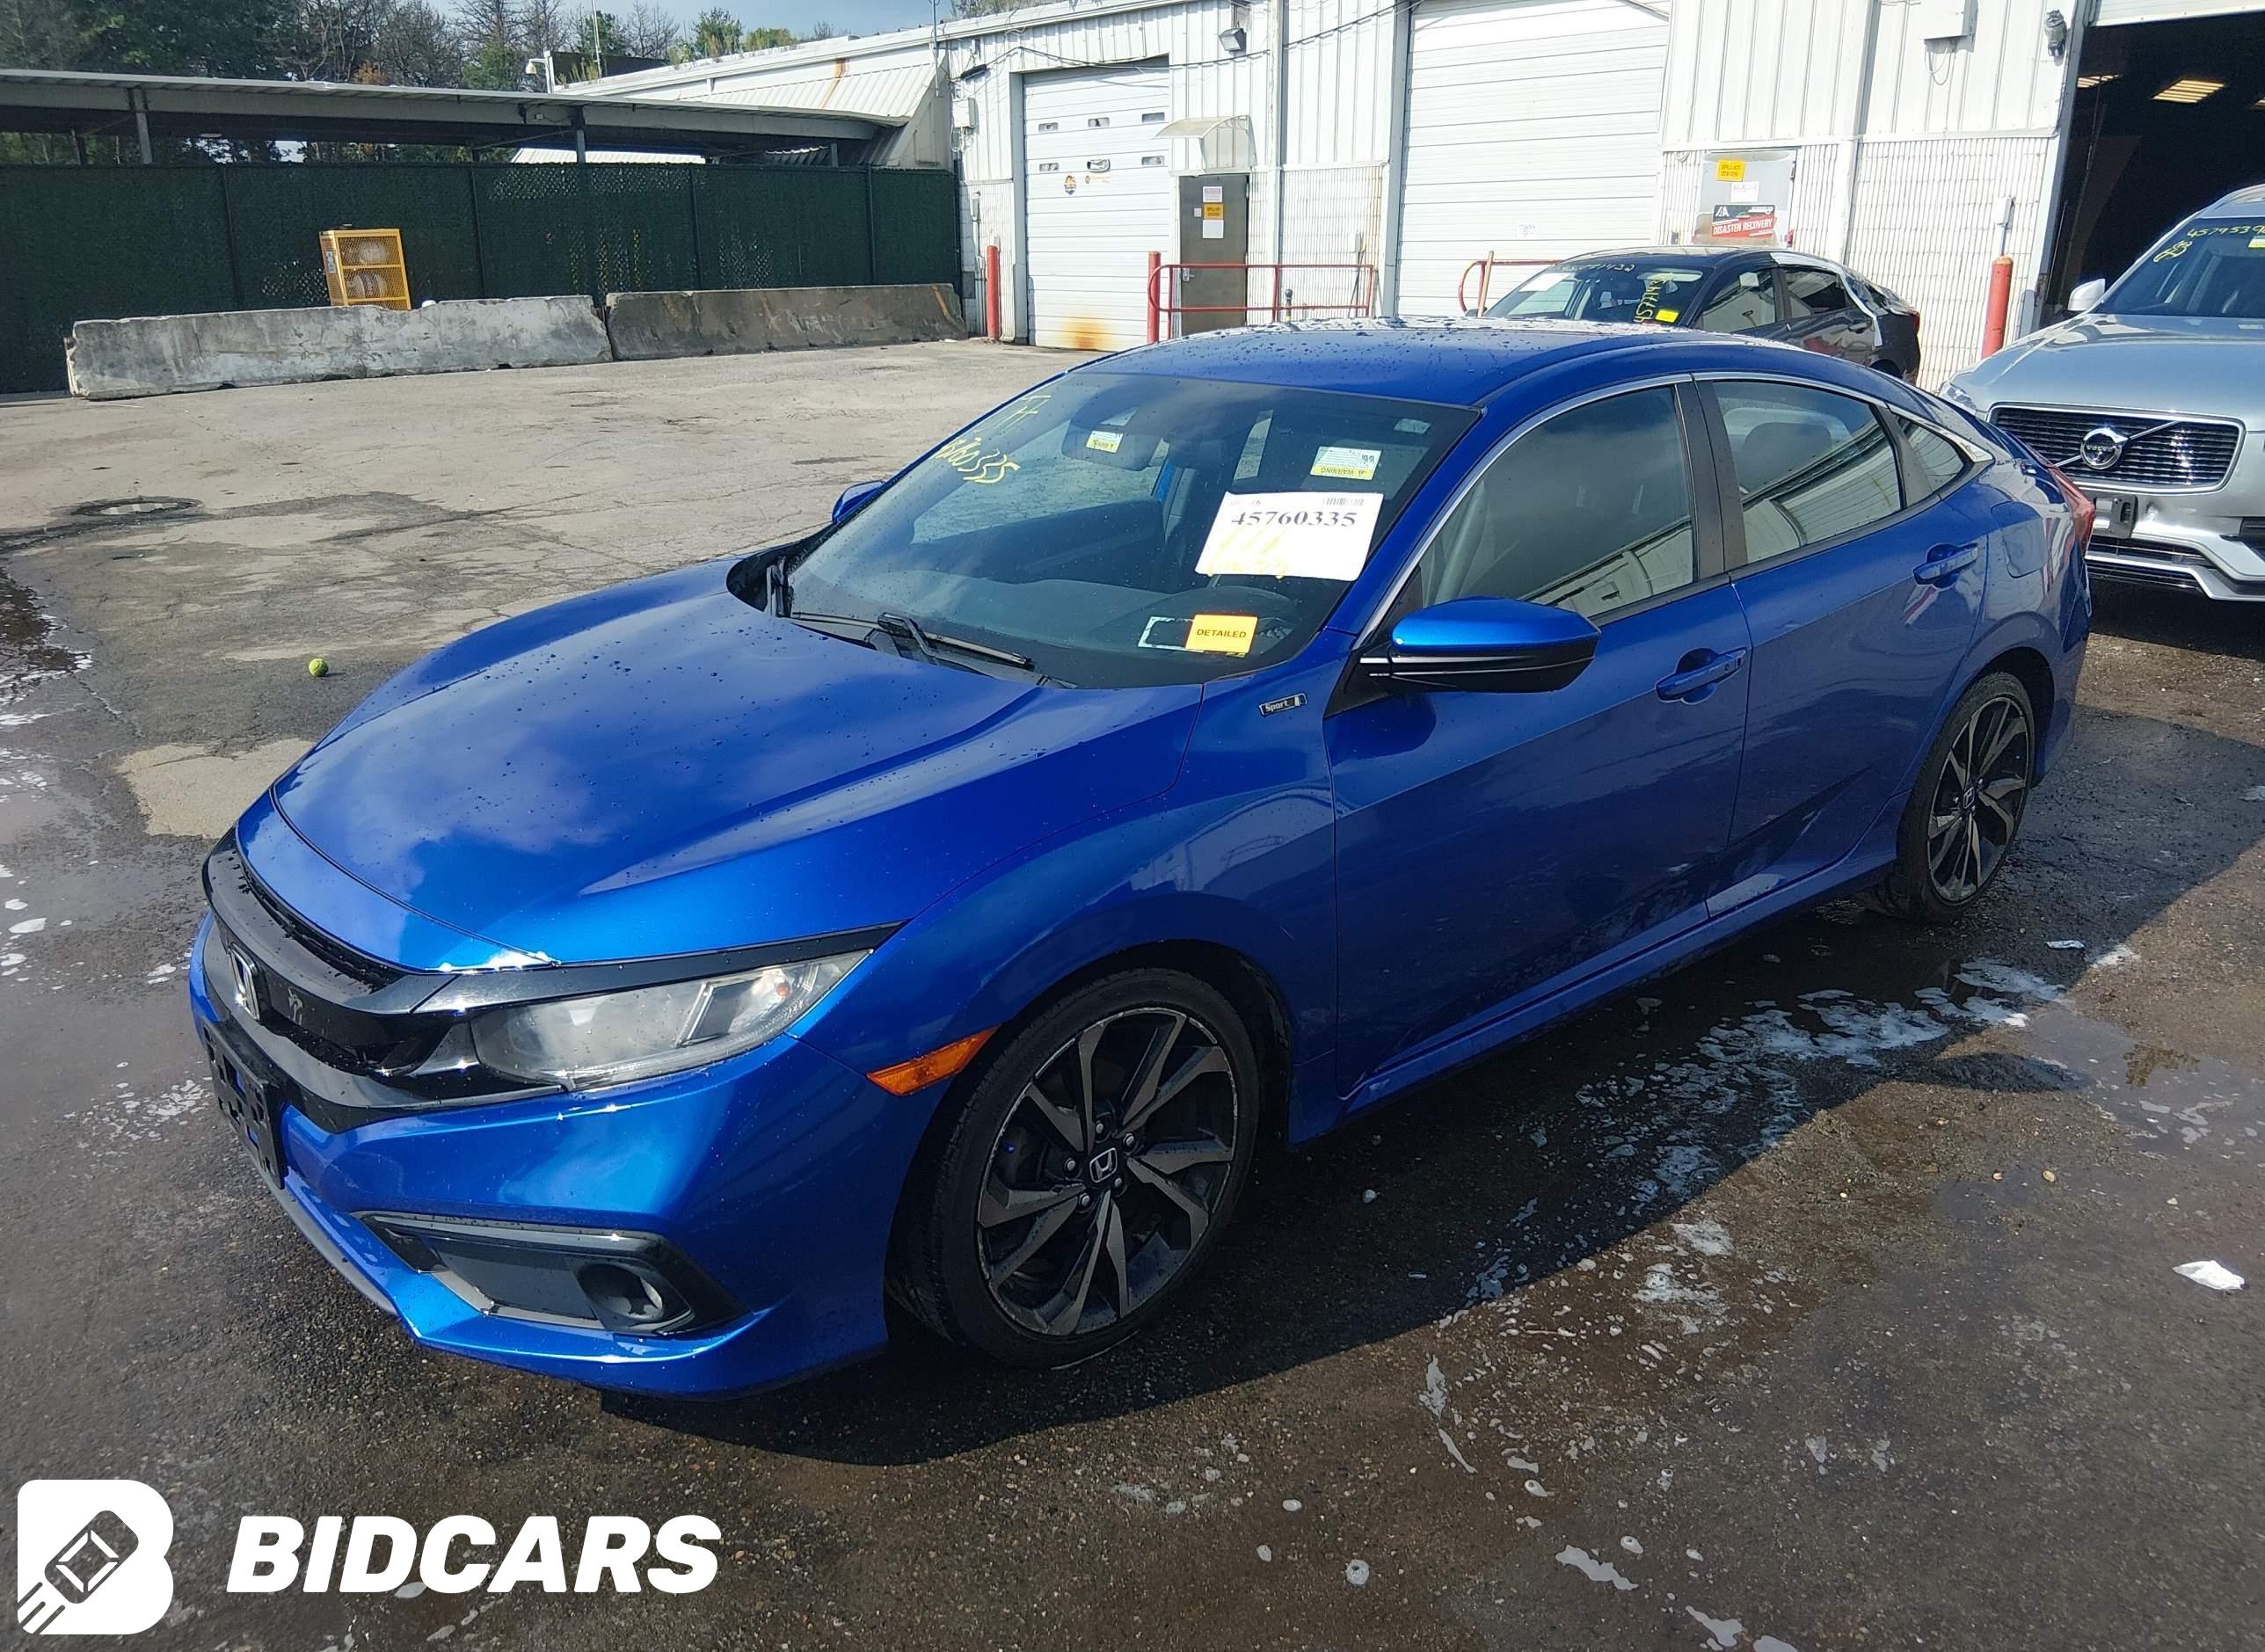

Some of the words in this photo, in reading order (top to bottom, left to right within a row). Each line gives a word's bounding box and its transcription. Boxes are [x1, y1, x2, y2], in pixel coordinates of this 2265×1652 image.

[1713, 222, 1742, 236] DISASTER
[1743, 218, 1773, 231] RECOVERY
[1633, 273, 1673, 323] 4577143
[1320, 467, 1355, 476] WARNING
[1230, 511, 1358, 527] 45760335
[1196, 628, 1247, 639] DETAILED
[1264, 701, 1288, 712] Sport
